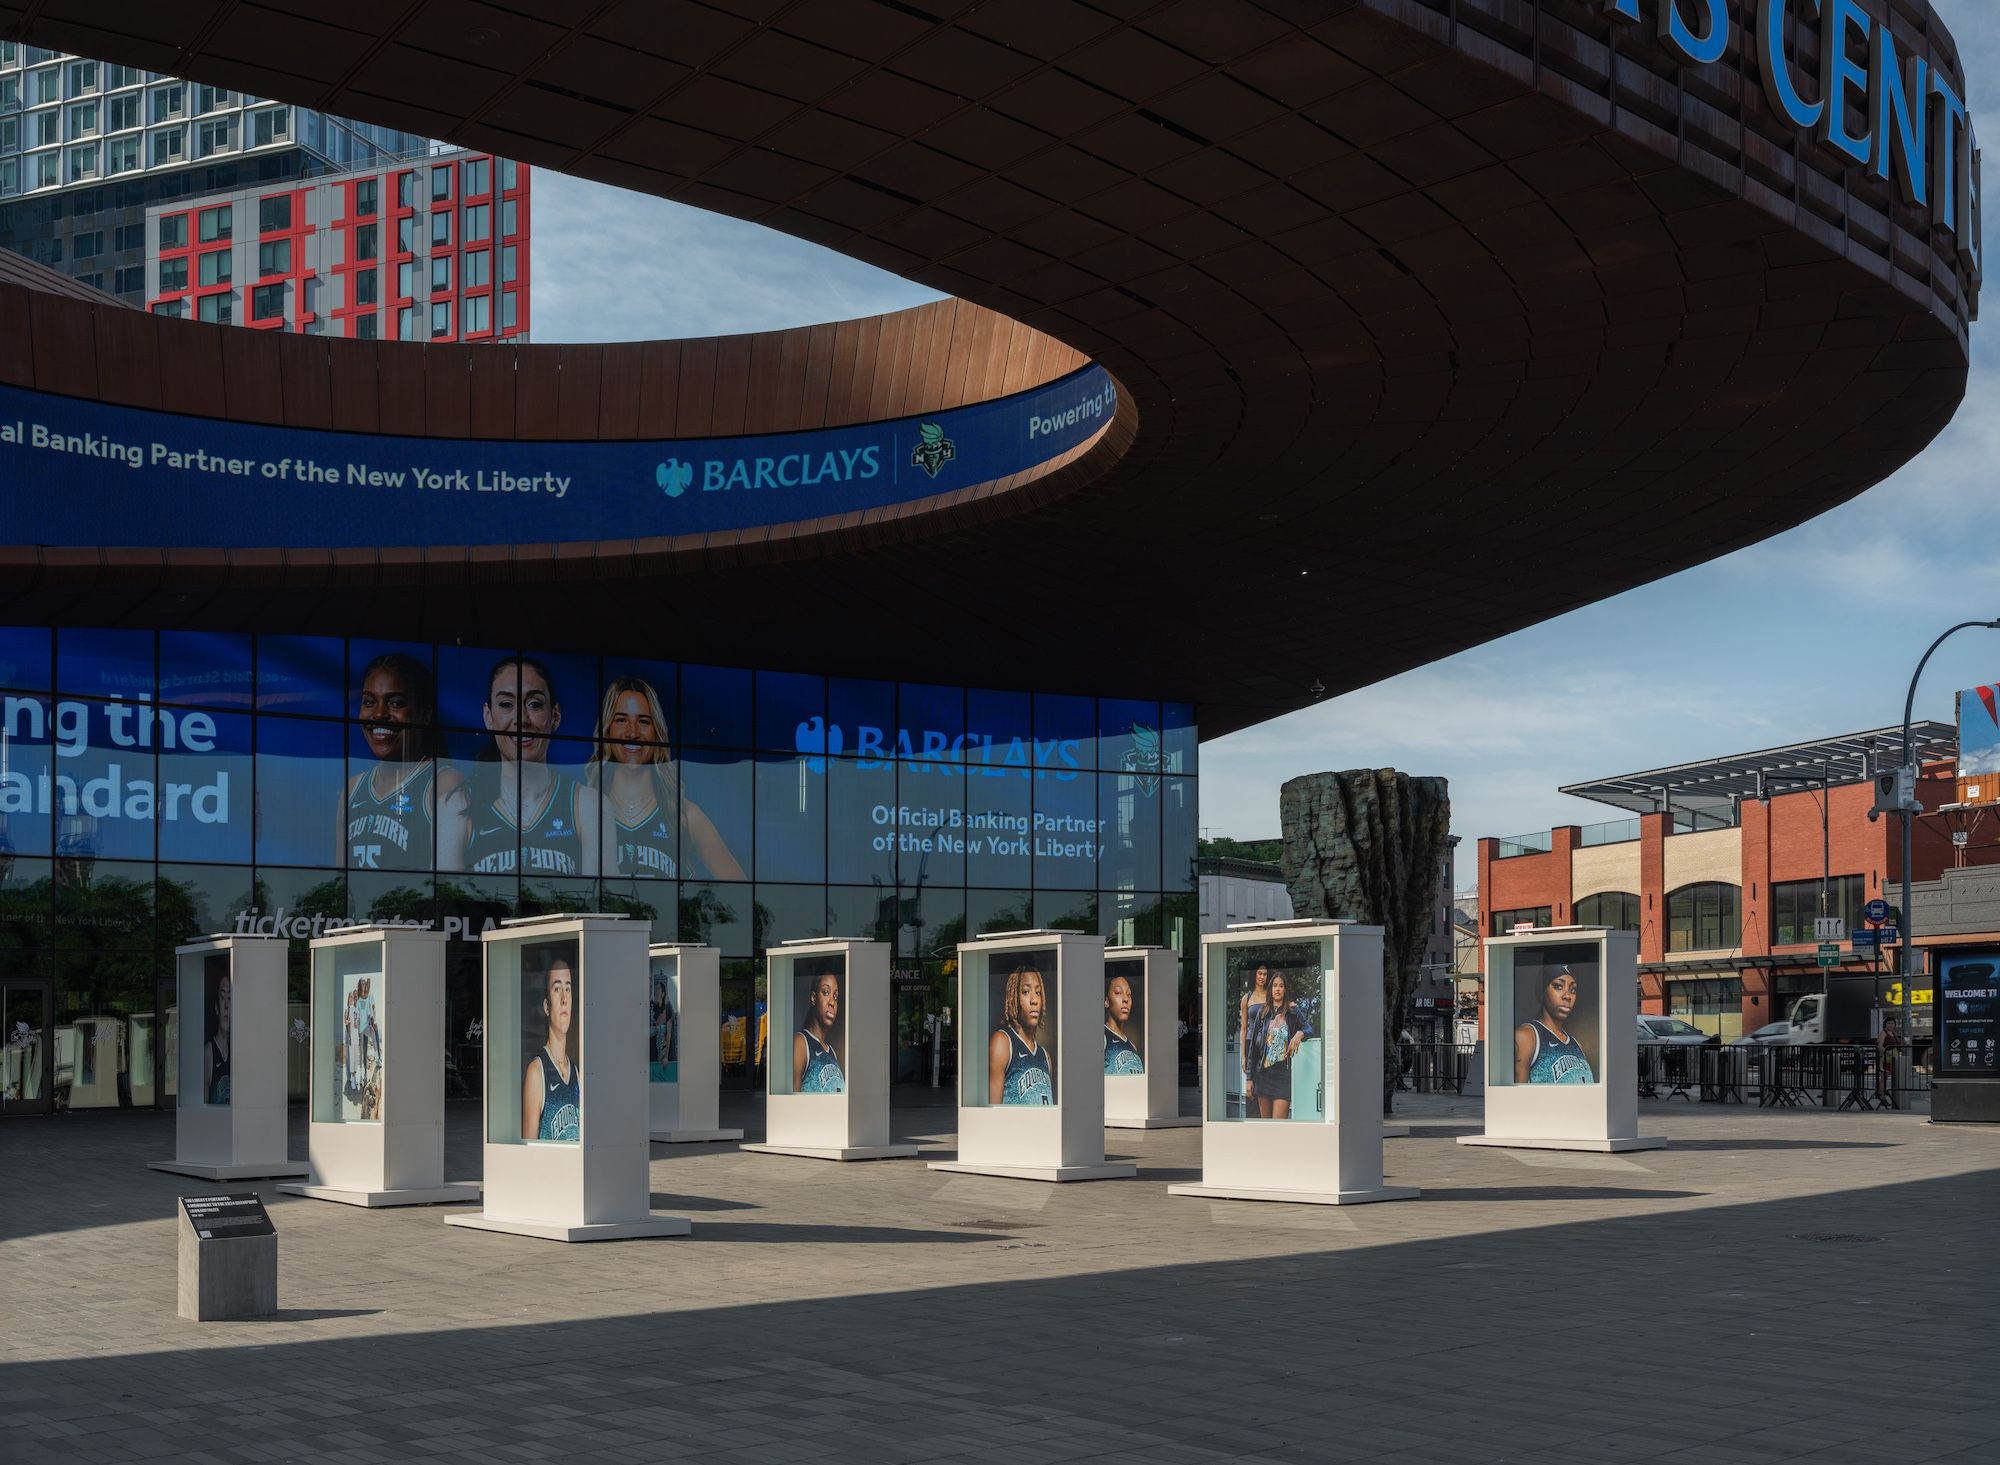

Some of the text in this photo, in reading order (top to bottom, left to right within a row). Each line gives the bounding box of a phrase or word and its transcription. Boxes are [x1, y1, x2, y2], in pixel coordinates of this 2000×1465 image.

[1757, 0, 1981, 274] CENTE
[1029, 394, 1103, 440] Powering
[0, 420, 571, 499] al Banking Partner of the New York Liberty
[702, 446, 881, 492] BARCLAYS
[5, 692, 217, 758] ng the
[856, 725, 1081, 782] BARCLAYS
[0, 764, 229, 824] andard
[372, 814, 410, 852] YORK
[871, 804, 1107, 836] Official Banking Partner
[872, 832, 1105, 863] of the New York Liberty
[1944, 989, 1986, 999] WELCOME
